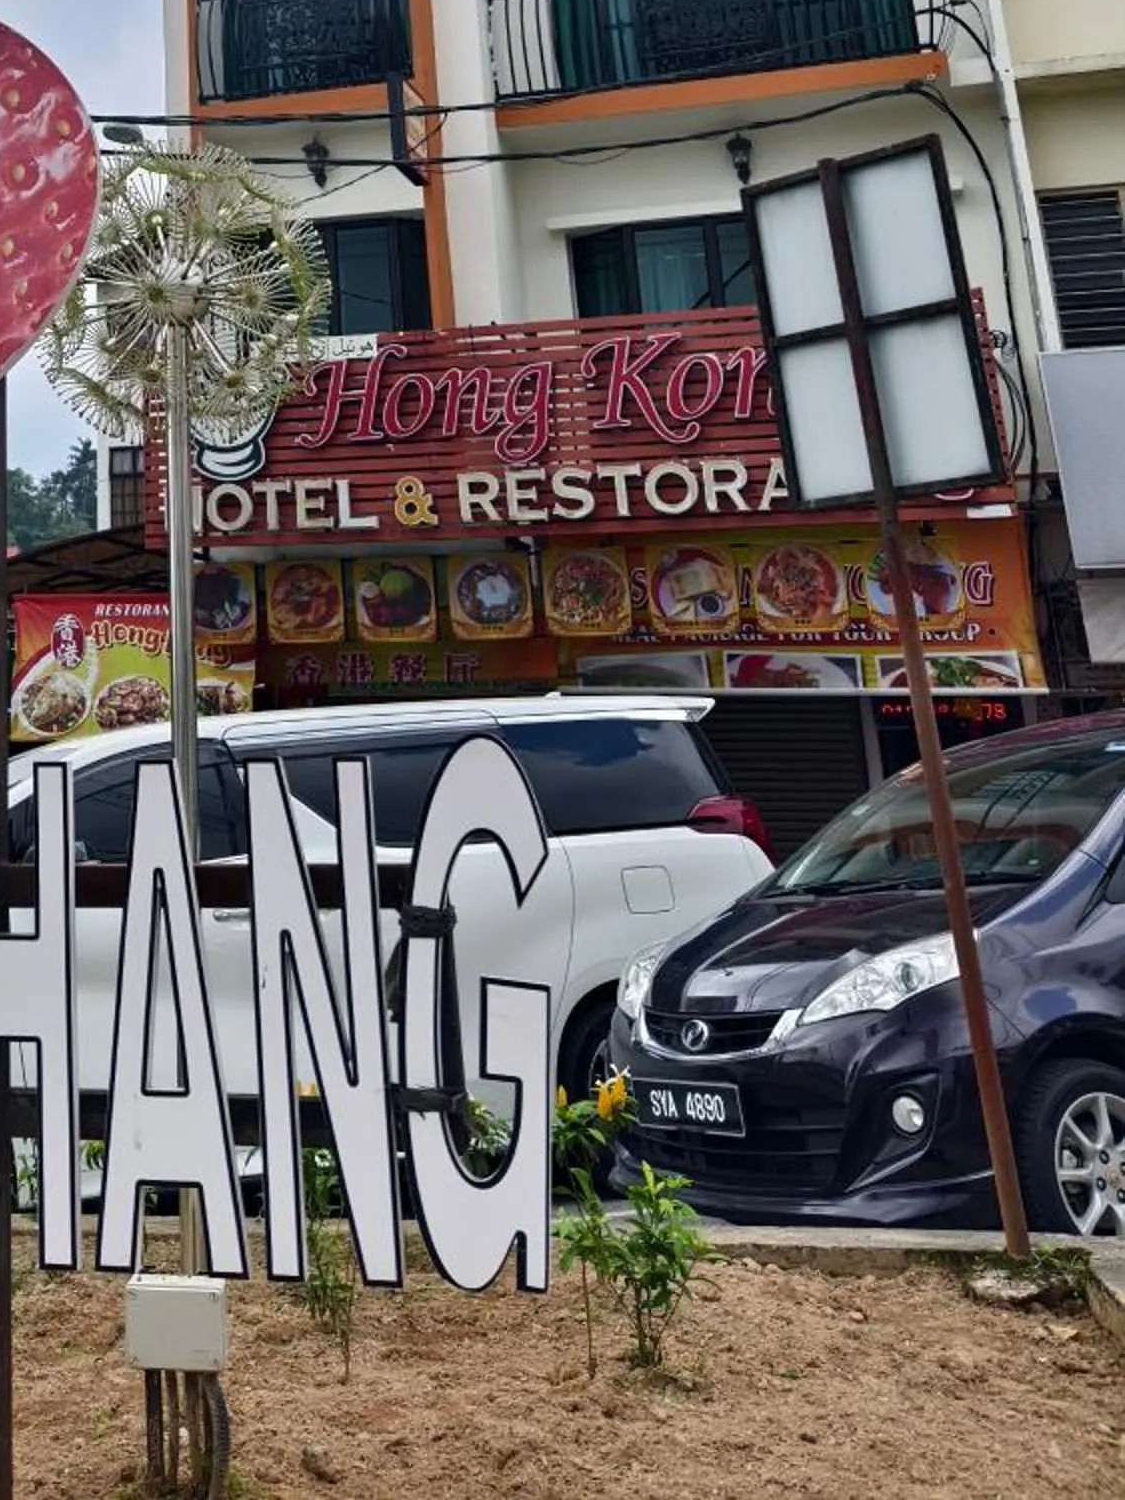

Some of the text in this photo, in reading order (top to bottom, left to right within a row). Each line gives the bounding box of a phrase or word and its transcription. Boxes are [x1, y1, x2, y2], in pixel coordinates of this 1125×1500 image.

[295, 331, 775, 464] Hong Kon
[394, 475, 439, 527] &
[456, 457, 789, 524] RESTORA
[91, 620, 164, 658] Hong
[649, 1089, 726, 1123] SYA 4890
